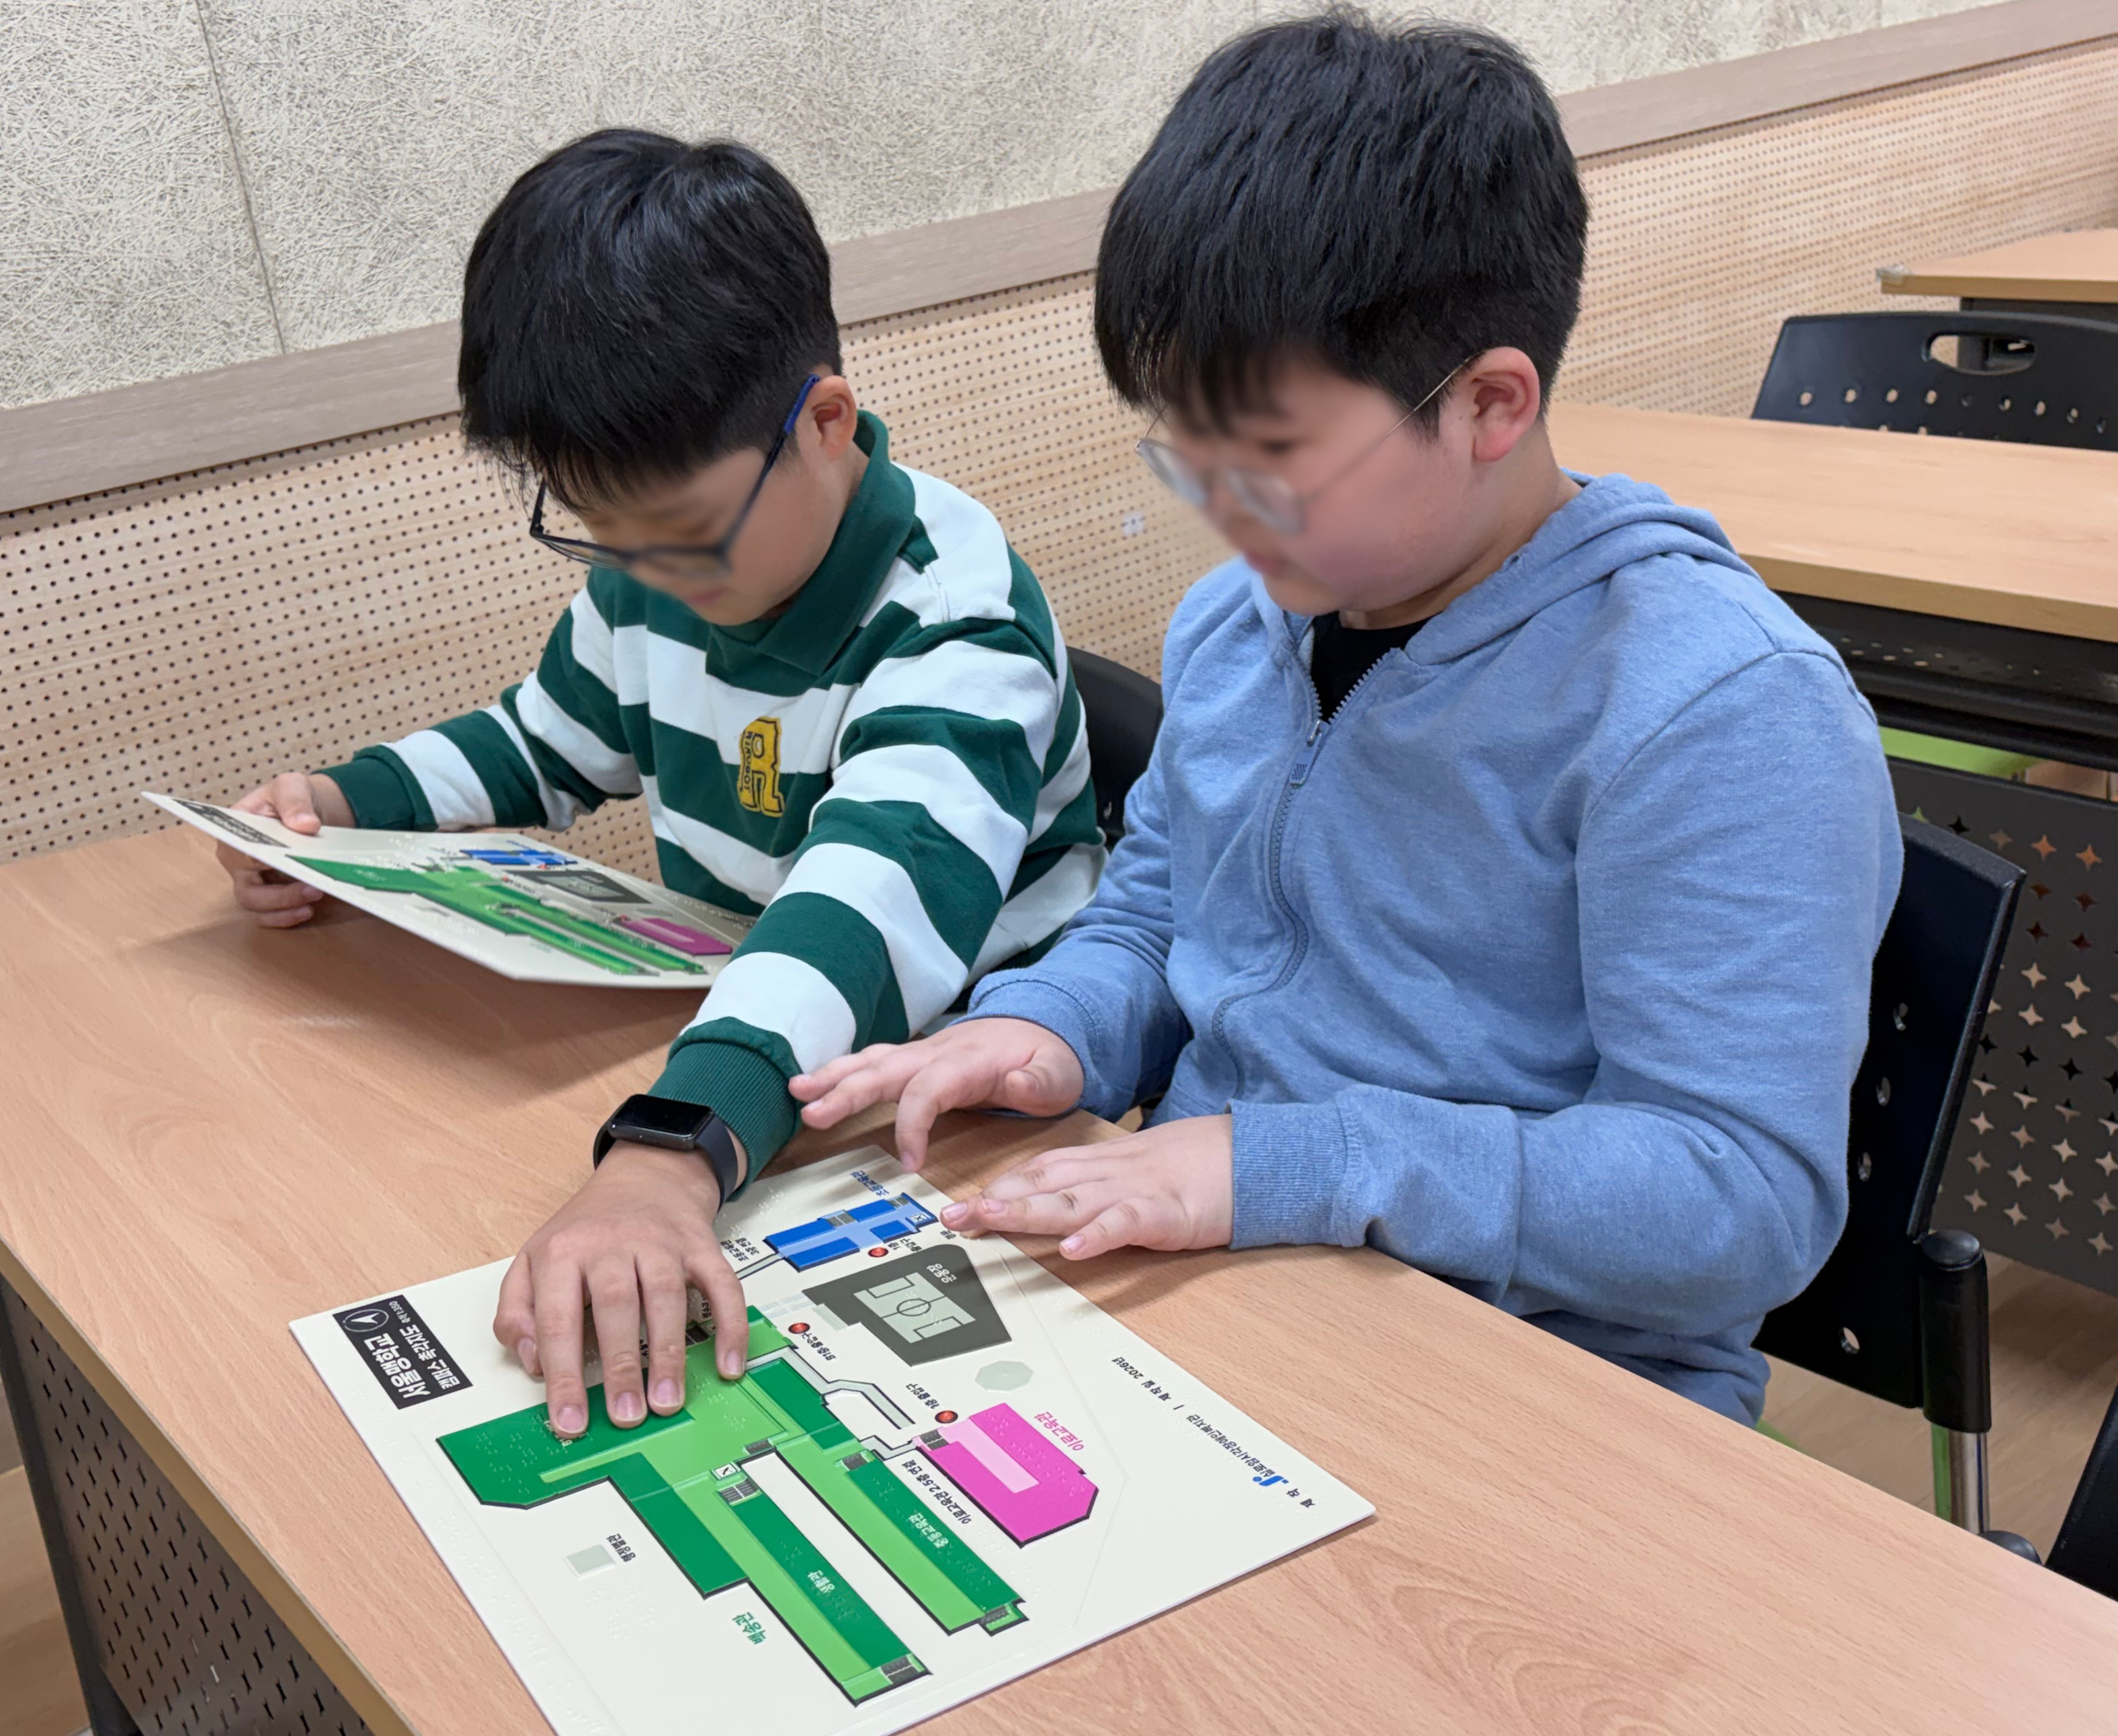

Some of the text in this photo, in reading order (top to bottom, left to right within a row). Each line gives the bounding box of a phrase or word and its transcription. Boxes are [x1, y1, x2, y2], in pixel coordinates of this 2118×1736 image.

[850, 1170, 889, 1196] 초등교육관
[927, 1264, 957, 1283] 운동장
[399, 1324, 437, 1361] 촉각지도
[364, 1333, 430, 1398] 서울맹학교
[427, 1359, 460, 1389] 캠퍼스
[1111, 1357, 1144, 1379] 2026년
[906, 1384, 940, 1409] 1층 출입구
[1034, 1412, 1084, 1450] 이료교육관
[916, 1474, 941, 1492] 2.5층
[933, 1491, 971, 1524] 이료교육관
[908, 1513, 948, 1548] 중등교육관
[732, 1612, 765, 1644] 백송관
